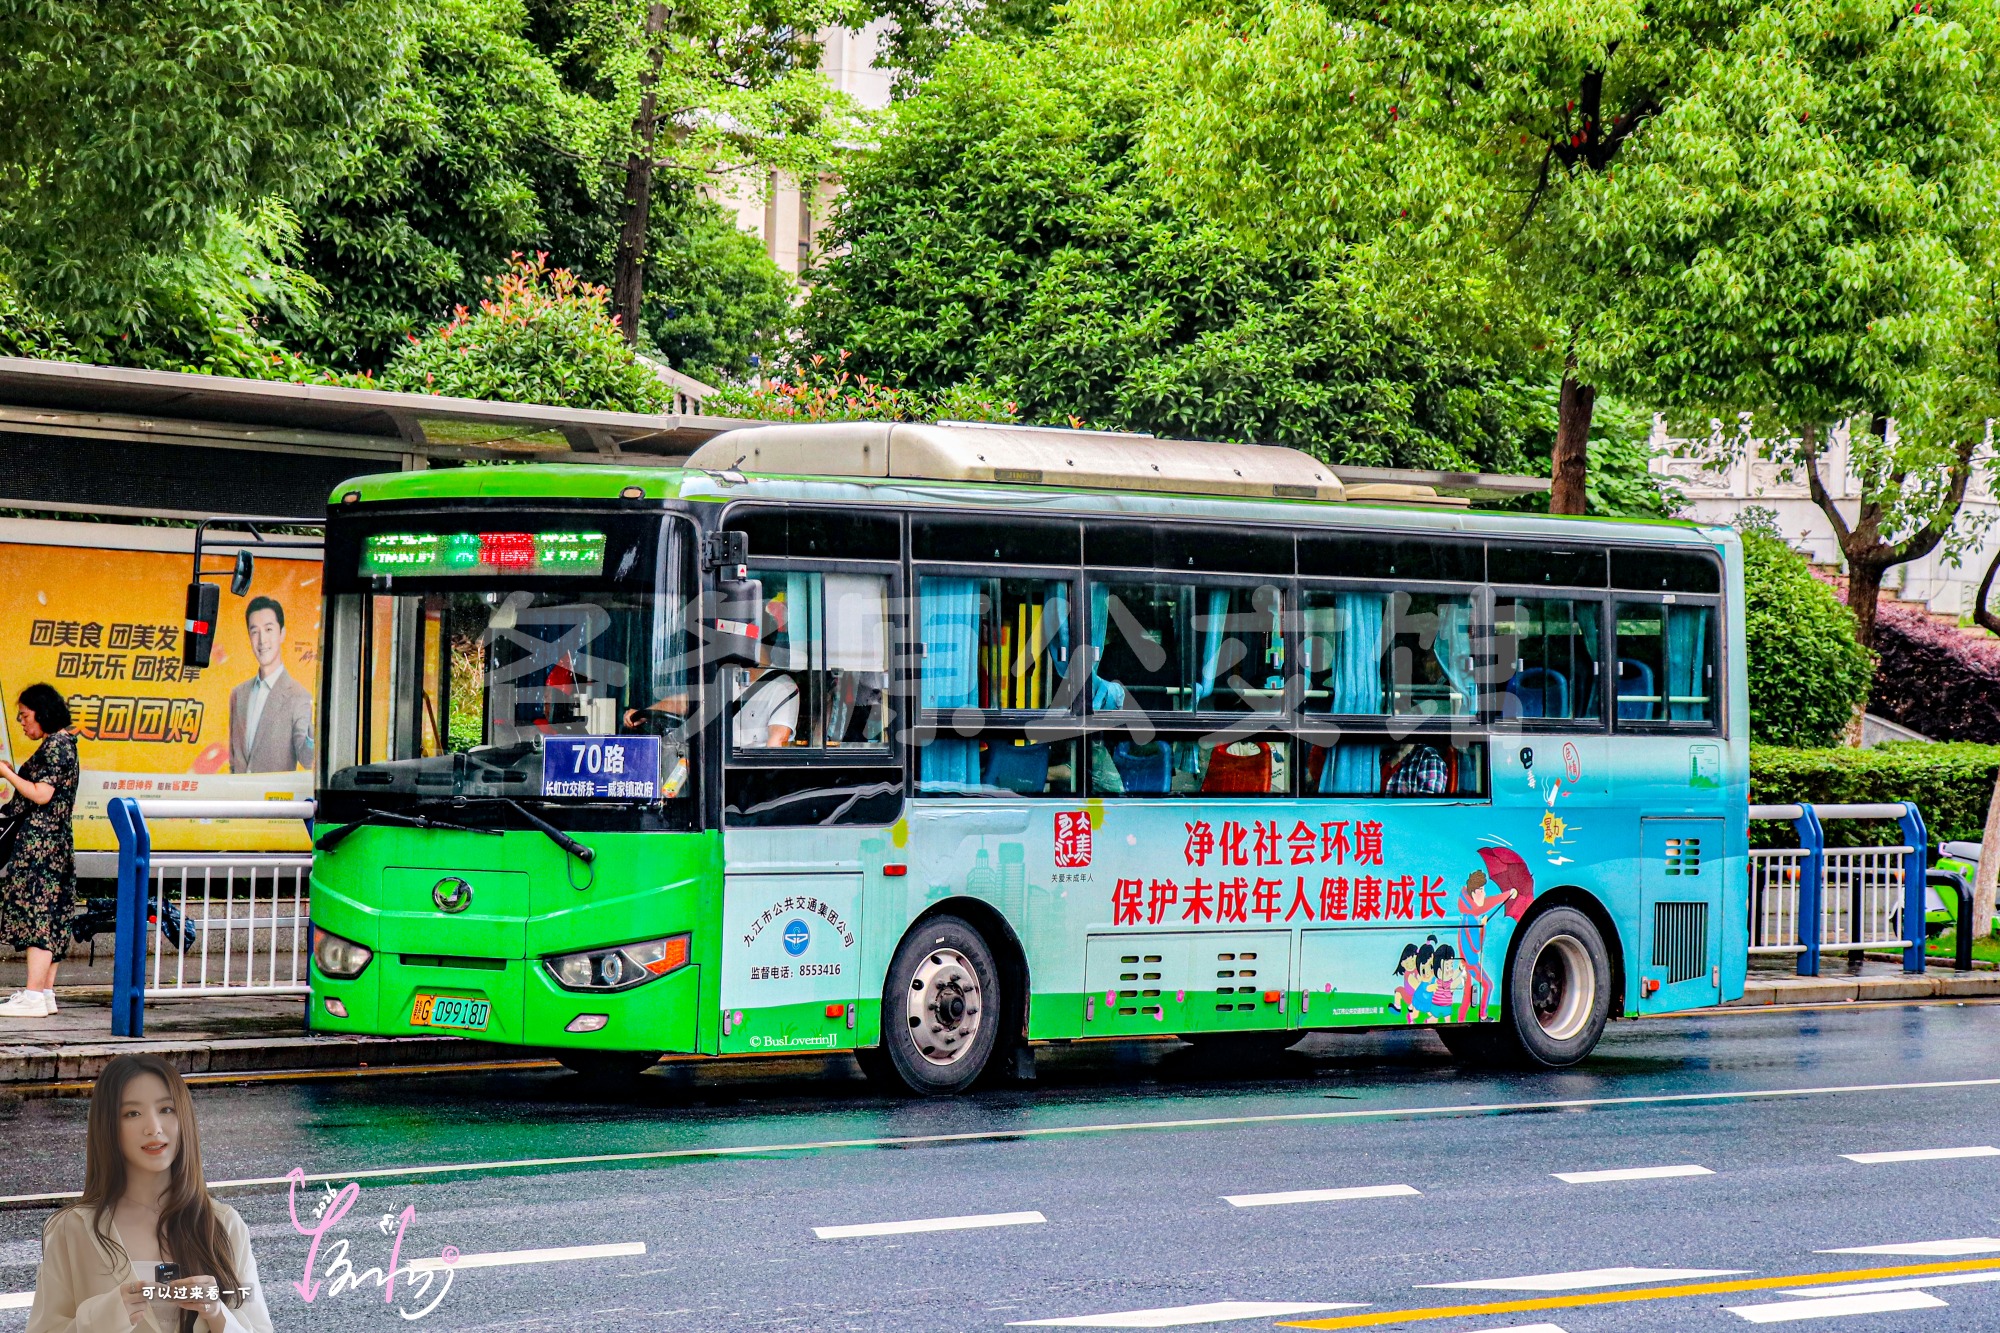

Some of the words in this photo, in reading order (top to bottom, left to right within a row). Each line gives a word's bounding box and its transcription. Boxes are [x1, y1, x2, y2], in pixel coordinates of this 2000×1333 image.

[29, 620, 103, 649] 团美食
[108, 623, 180, 652] 团美发
[55, 652, 128, 680] 团玩乐
[67, 694, 204, 744] 美团团购
[572, 744, 625, 774] 70路
[1183, 819, 1385, 867] 净化社会环境
[1051, 873, 1094, 883] 关爱未成年人
[1111, 874, 1447, 926] 保护未成年人健康成长
[743, 895, 855, 948] 九江市公共交通集团公司
[799, 964, 841, 976] 8553416
